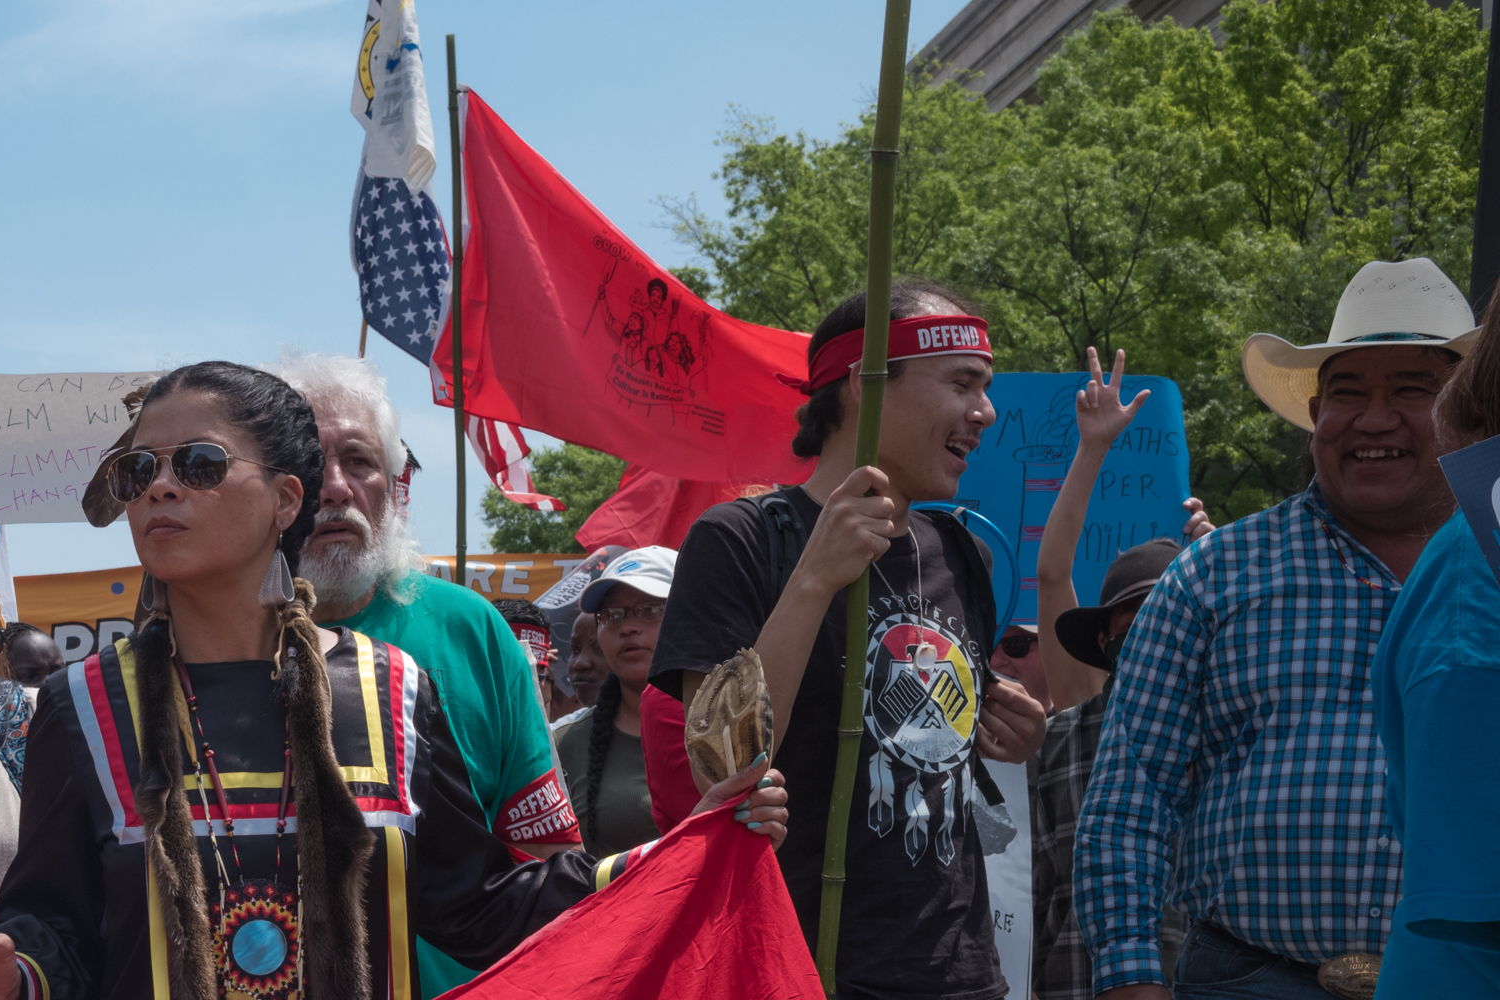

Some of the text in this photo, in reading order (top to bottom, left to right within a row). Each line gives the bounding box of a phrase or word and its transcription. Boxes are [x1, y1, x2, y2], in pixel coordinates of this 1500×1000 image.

[917, 325, 980, 350] DEFEND
[17, 377, 83, 393] CAN
[108, 375, 150, 391] BE
[612, 376, 640, 396] Cultivar
[86, 404, 130, 425] WI
[1109, 427, 1180, 456] EATHS
[1100, 470, 1162, 501] PER
[553, 577, 590, 606] MARCH
[508, 780, 561, 822] DEFEND
[510, 805, 576, 842] PROTECT
